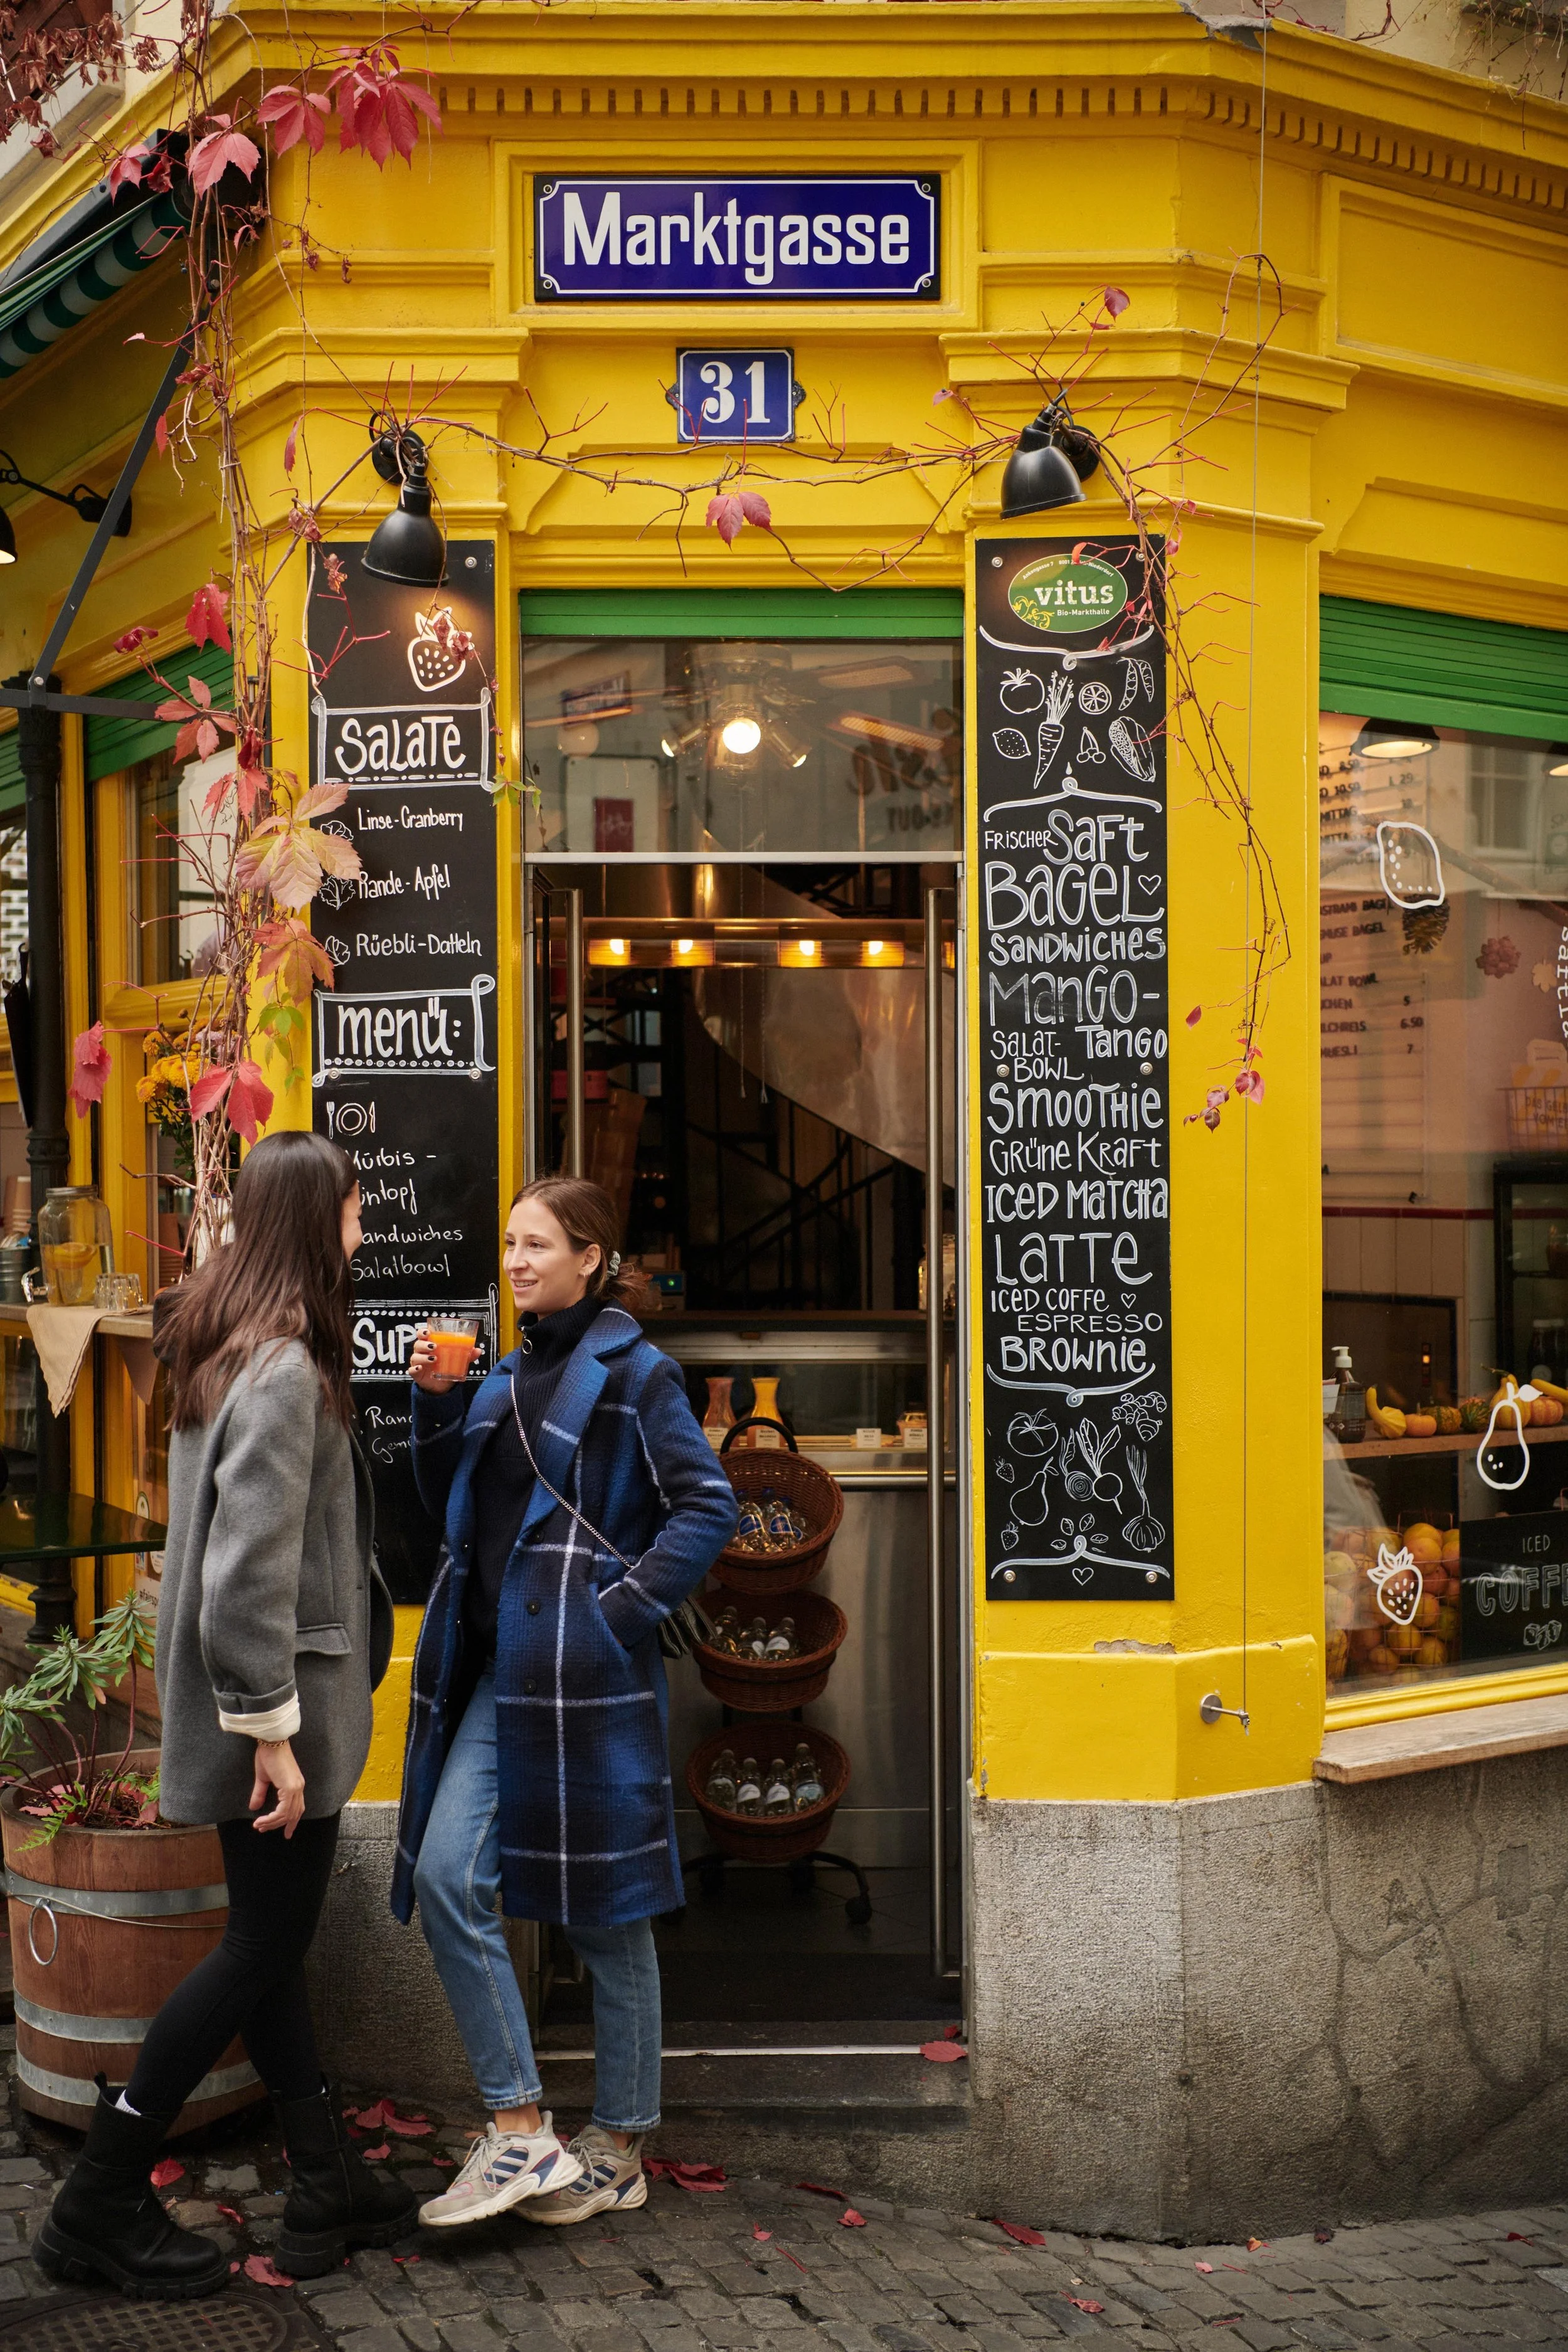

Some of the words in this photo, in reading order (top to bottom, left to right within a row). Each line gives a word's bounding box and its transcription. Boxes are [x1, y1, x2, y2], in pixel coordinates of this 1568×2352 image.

[564, 191, 909, 285] Marktgasse
[700, 361, 770, 423] 31
[1022, 563, 1049, 580] Ankengasse
[1034, 580, 1114, 606] vitus
[1057, 608, 1110, 617] Bio-Markthalle
[1353, 922, 1386, 936] BAGEL
[356, 931, 482, 956] Rüebli-Datteln
[1014, 1057, 1084, 1083] BOWL
[357, 1179, 418, 1216] intopf
[362, 1224, 463, 1244] andwiches
[1017, 1313, 1163, 1333] ESPRESSO
[1522, 1534, 1550, 1554] ICED
